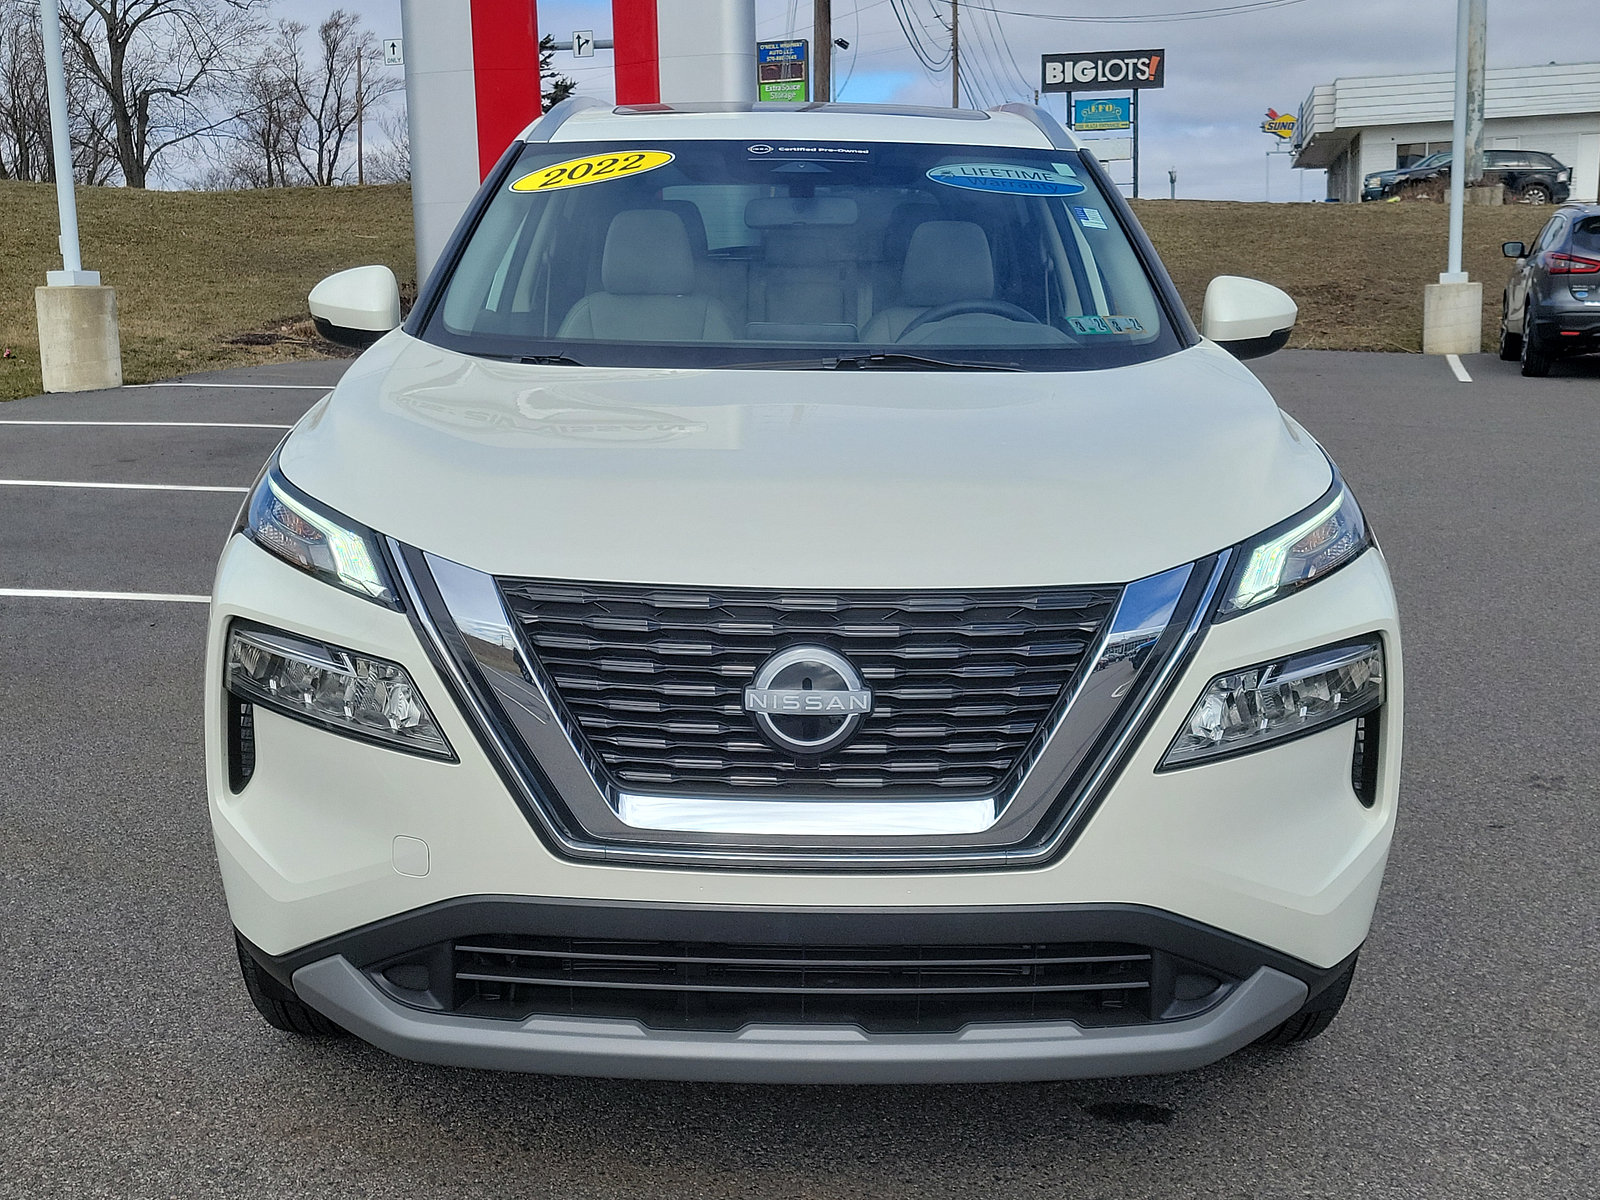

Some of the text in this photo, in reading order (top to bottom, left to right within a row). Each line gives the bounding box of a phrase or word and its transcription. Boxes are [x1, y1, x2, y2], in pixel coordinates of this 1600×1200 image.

[770, 92, 797, 101] Storage
[538, 154, 646, 188] 2022
[960, 166, 1056, 182] LIFETIME
[968, 176, 1059, 194] Warranty
[1093, 317, 1109, 332] 24
[1128, 318, 1145, 331] 24
[749, 693, 868, 710] NISSAN
